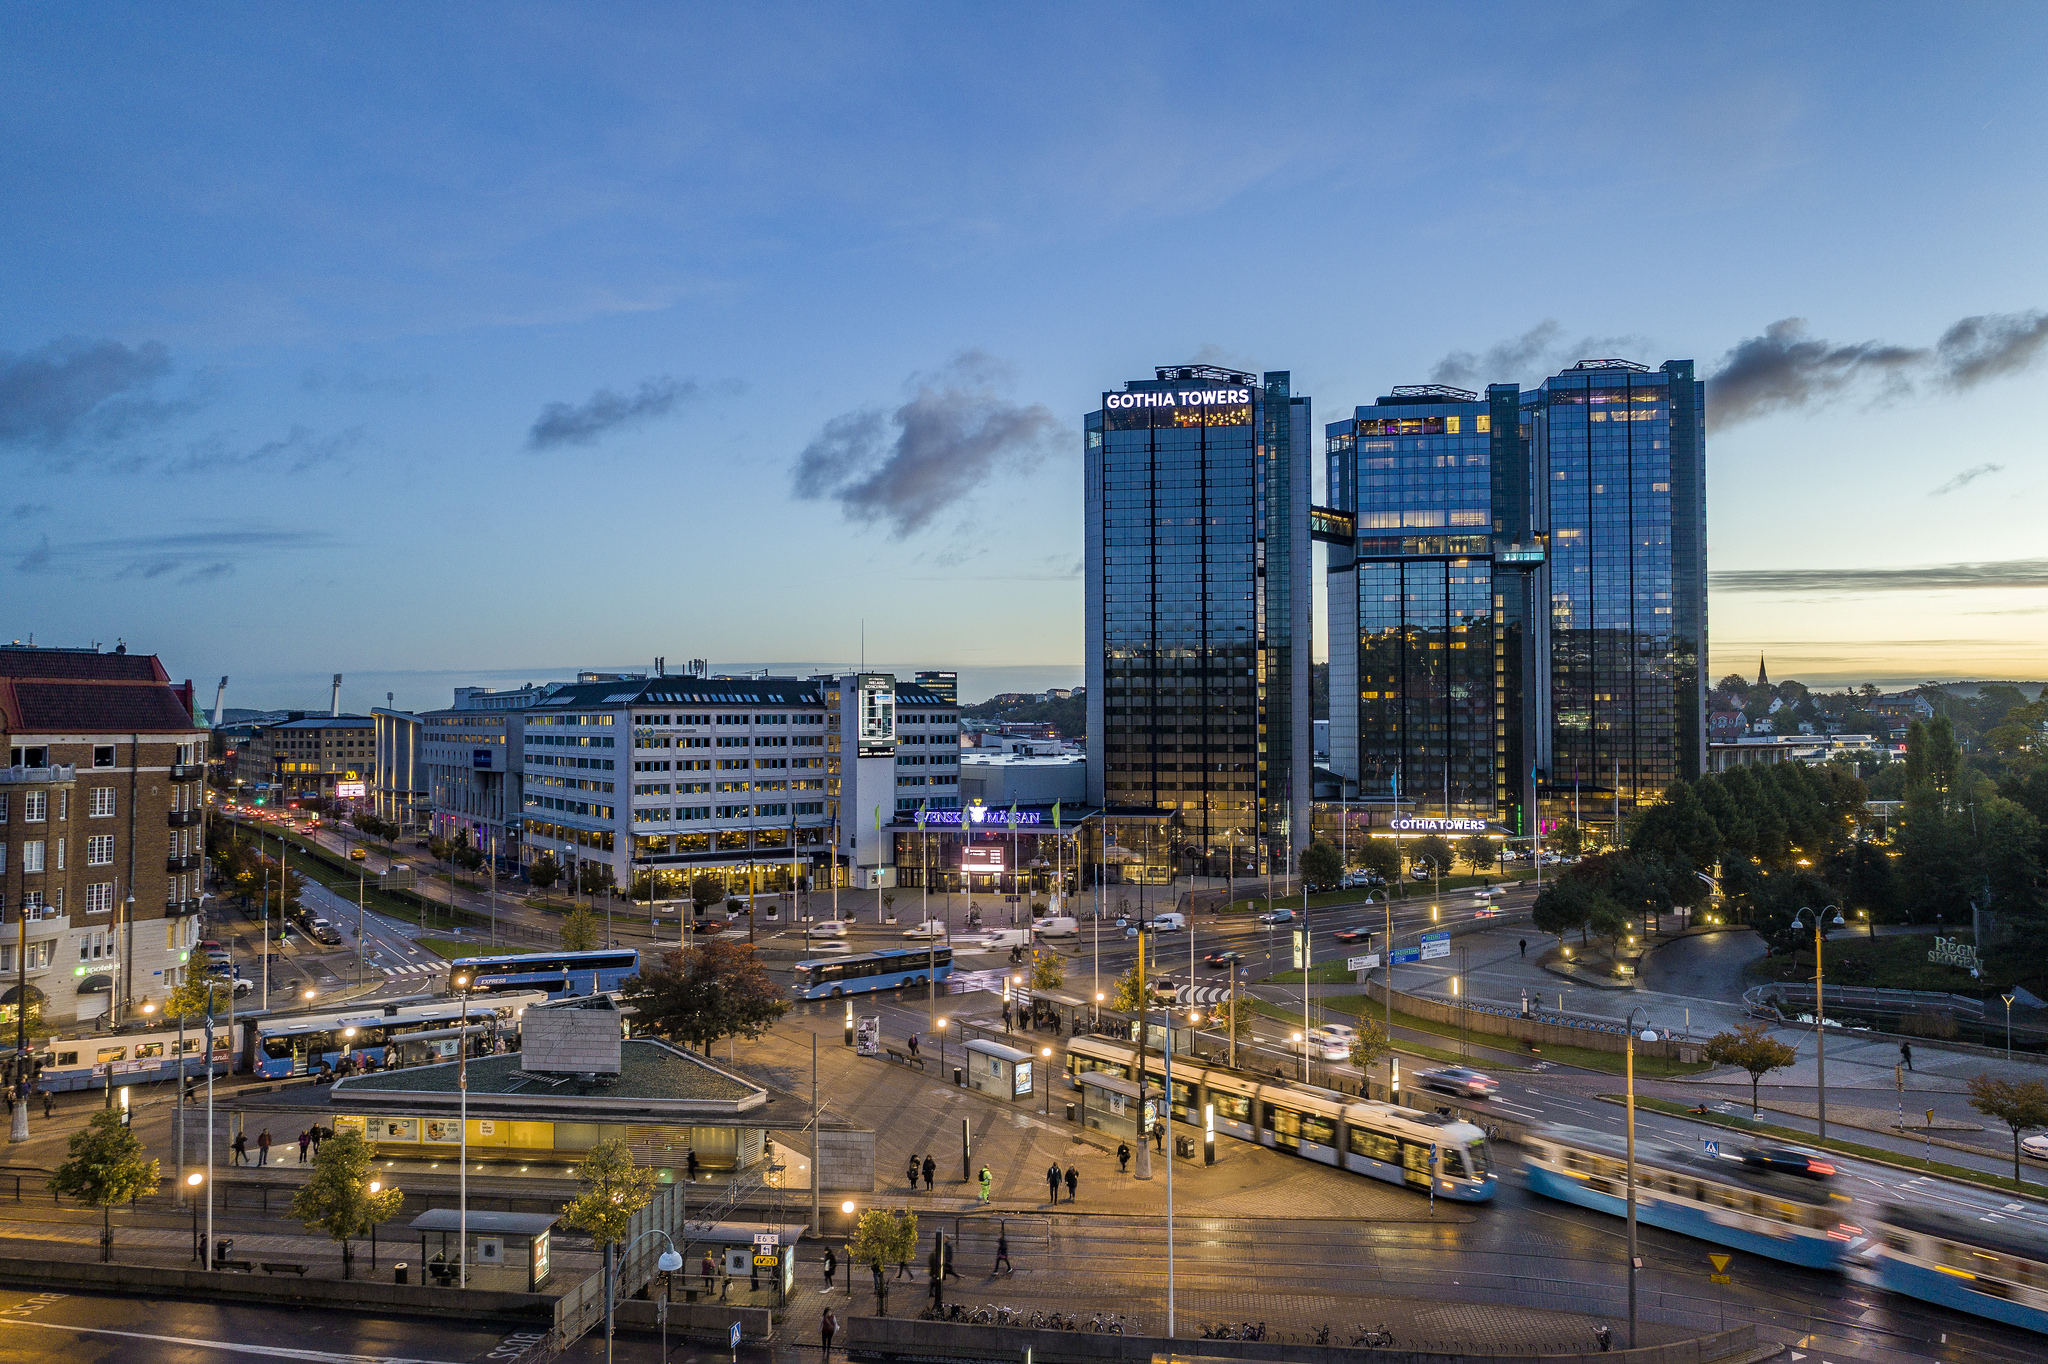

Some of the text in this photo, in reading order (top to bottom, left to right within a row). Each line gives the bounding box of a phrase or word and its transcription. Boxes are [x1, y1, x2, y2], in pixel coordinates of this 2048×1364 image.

[1107, 389, 1250, 409] GOTHIA TOWERS
[914, 810, 1040, 824] SVENSKA MÄSSAN
[1390, 819, 1486, 830] GOTHIA TOWERS
[86, 963, 120, 974] apoteket
[1928, 951, 1984, 970] SKOGEN
[0, 1292, 70, 1316] BUSS
